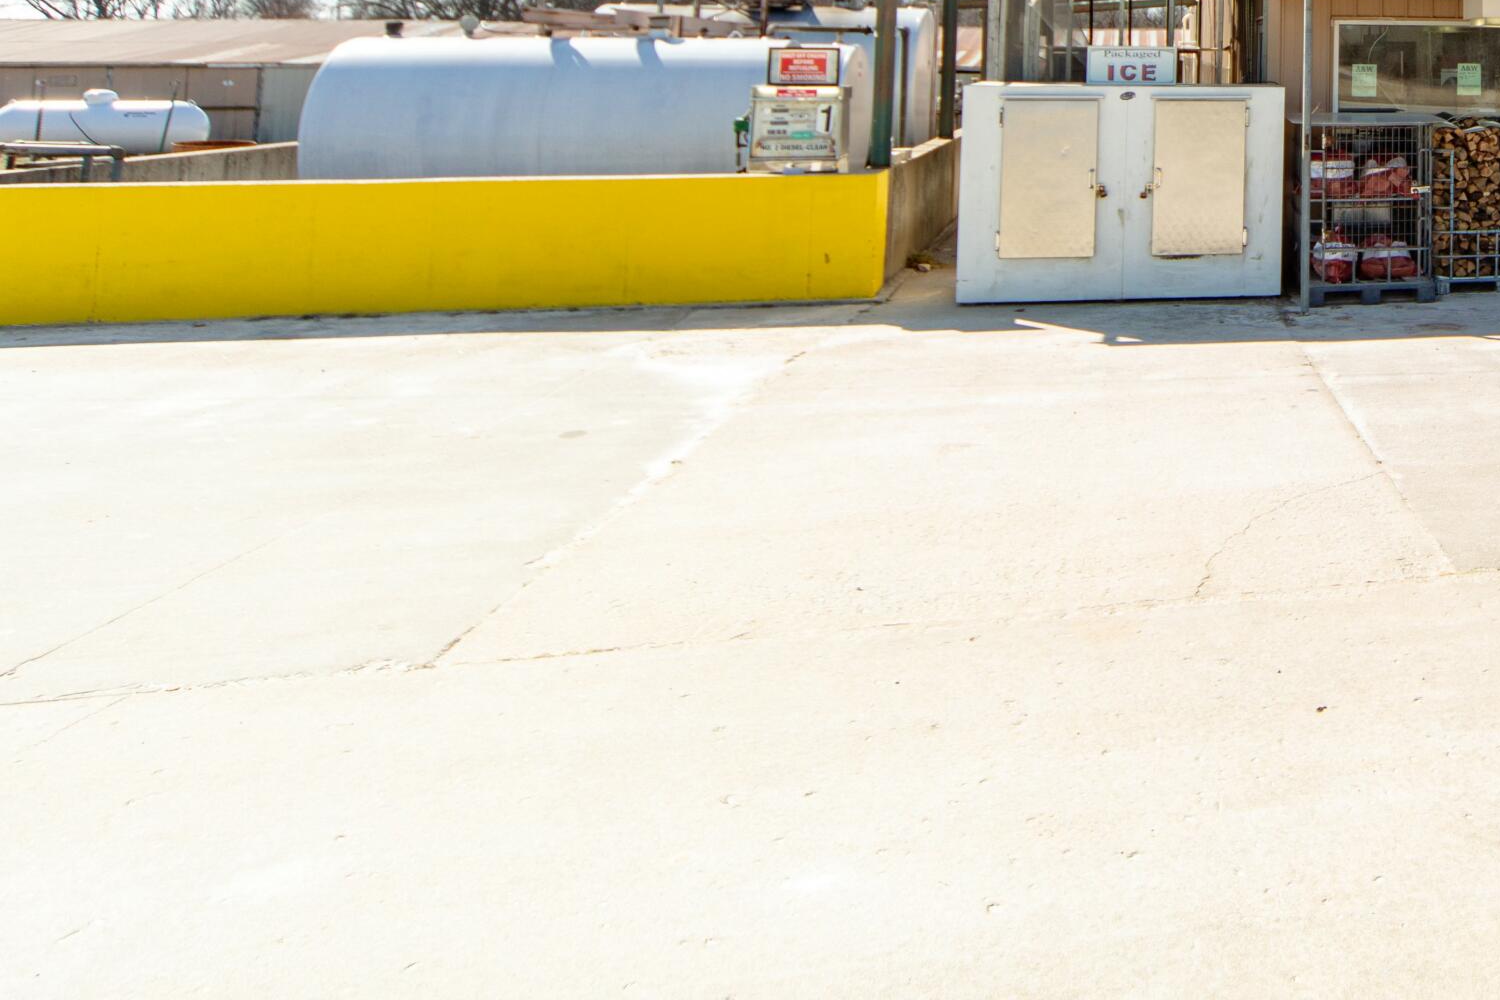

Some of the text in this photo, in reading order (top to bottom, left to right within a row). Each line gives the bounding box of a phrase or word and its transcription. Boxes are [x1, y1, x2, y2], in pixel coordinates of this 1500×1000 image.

[1104, 48, 1161, 59] Packaged
[1107, 64, 1156, 81] ICE
[820, 105, 832, 132] 1
